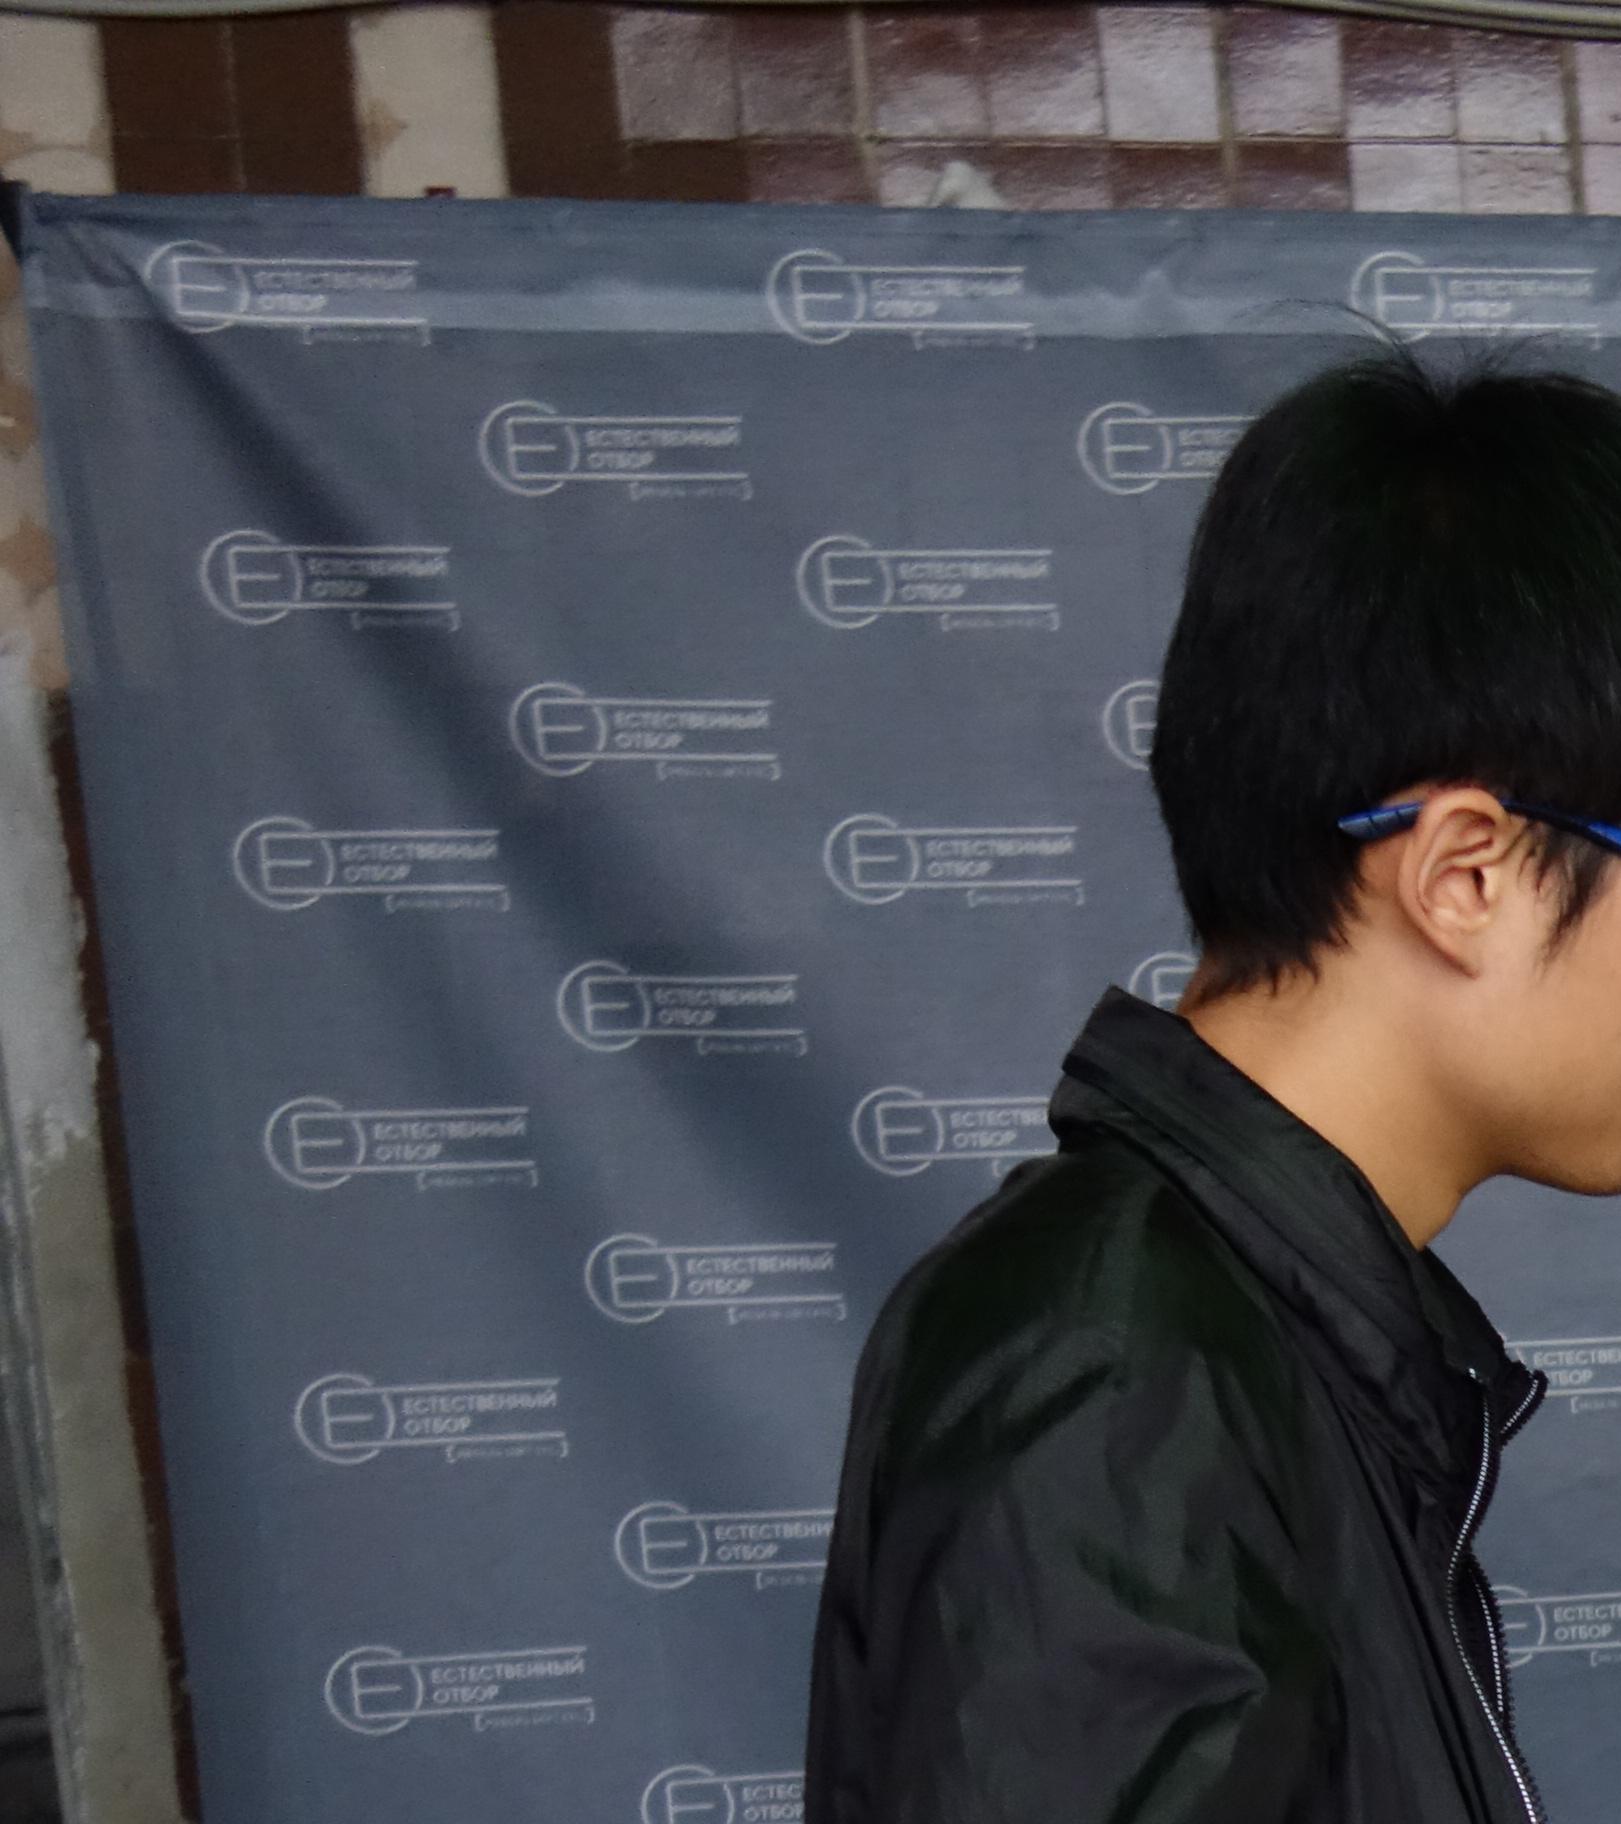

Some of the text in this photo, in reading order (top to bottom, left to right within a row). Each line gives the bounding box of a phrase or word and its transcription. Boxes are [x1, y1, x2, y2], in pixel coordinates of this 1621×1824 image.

[615, 710, 768, 729] ЕСТЕСТВЕННЫЙ
[617, 732, 684, 750] ОТБОР
[342, 839, 498, 861] ЕСТЕСТВЕННЫЙ
[927, 836, 1073, 857] ЕСТЕСТВЕННЫЙ
[344, 865, 413, 882] ОТБОР
[928, 861, 993, 877] ОТБОР
[655, 985, 795, 1005] ЕСТЕСТВЕННЫЙ
[658, 1009, 720, 1026] ОТБОР
[373, 1117, 527, 1140] ЕСТЕСТВЕННЫЙ
[954, 1131, 1019, 1147] ОТБОР
[375, 1144, 443, 1161] ОТБОР
[687, 1251, 834, 1275] ЕСТЕСТВЕННЫЙ
[689, 1279, 754, 1295] ОТБОР
[403, 1388, 557, 1415] ЕСТЕСТВЕННЫЙ
[405, 1417, 473, 1435] ОТБОР
[717, 1544, 780, 1561] ОТБОР
[1555, 1624, 1614, 1641] ОТБОР
[432, 1655, 584, 1685] ЕСТЕСТВЕННЫЙ
[433, 1686, 501, 1705] ОТБОР
